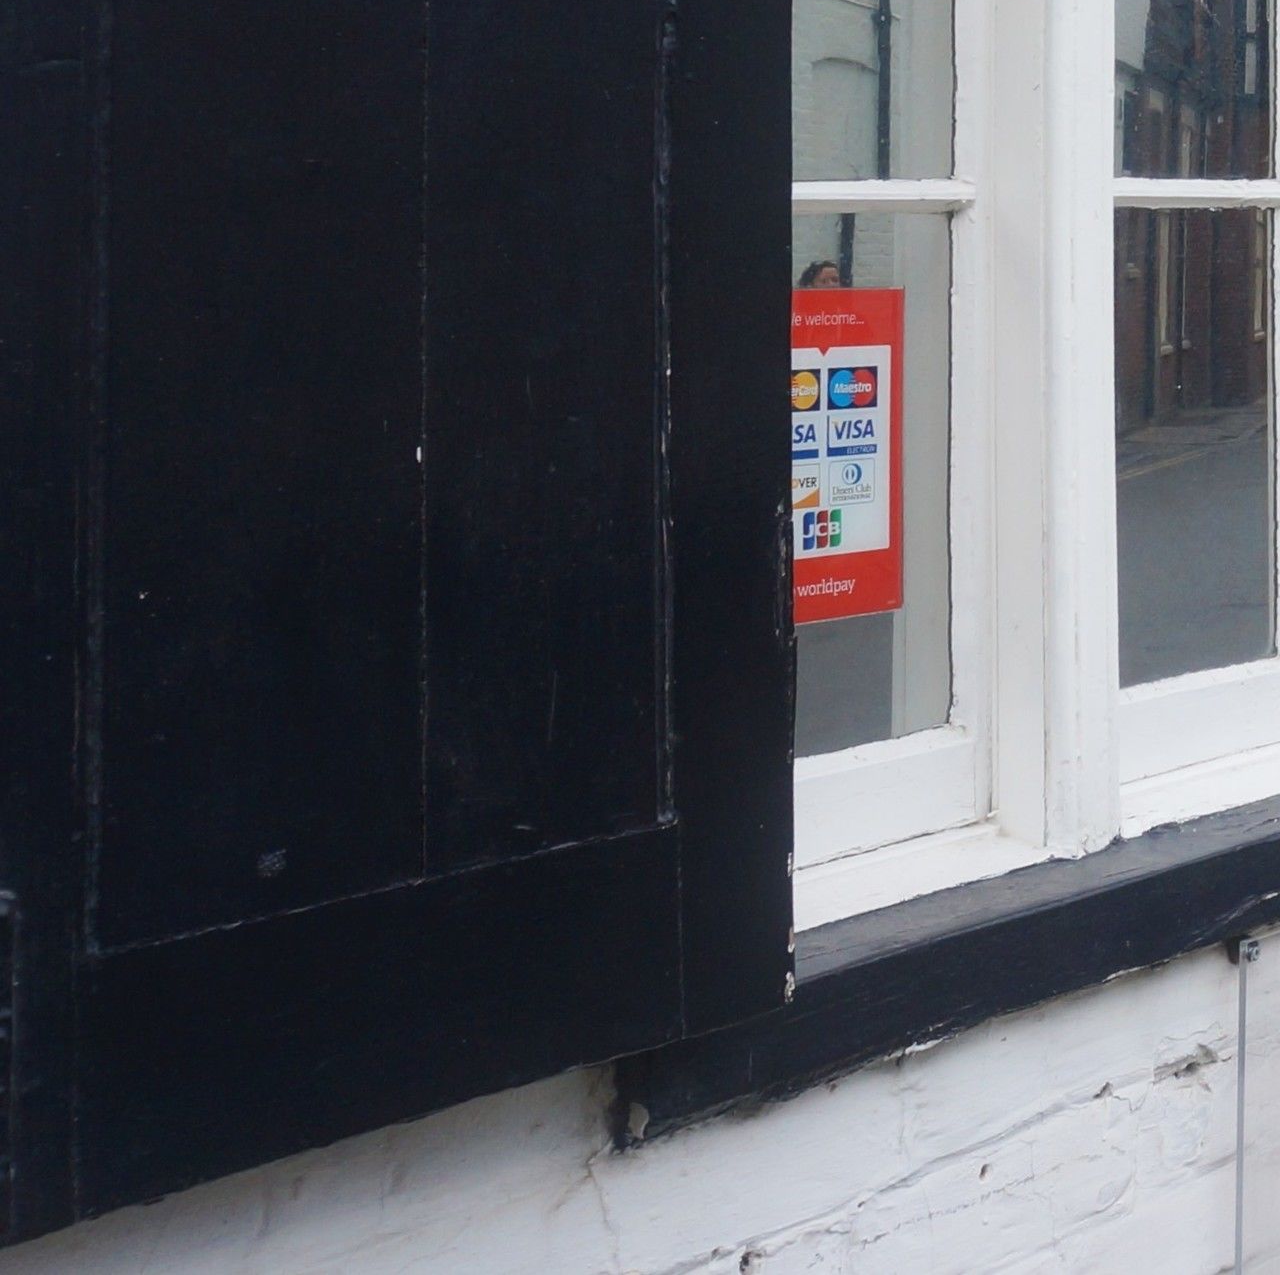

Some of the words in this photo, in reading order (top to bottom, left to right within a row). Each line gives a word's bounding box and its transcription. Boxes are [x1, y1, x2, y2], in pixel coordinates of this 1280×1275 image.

[833, 383, 872, 394] Maestro
[833, 419, 875, 440] VISA
[855, 484, 872, 494] Club
[803, 521, 841, 538] JCB
[797, 578, 856, 597] worldpay
